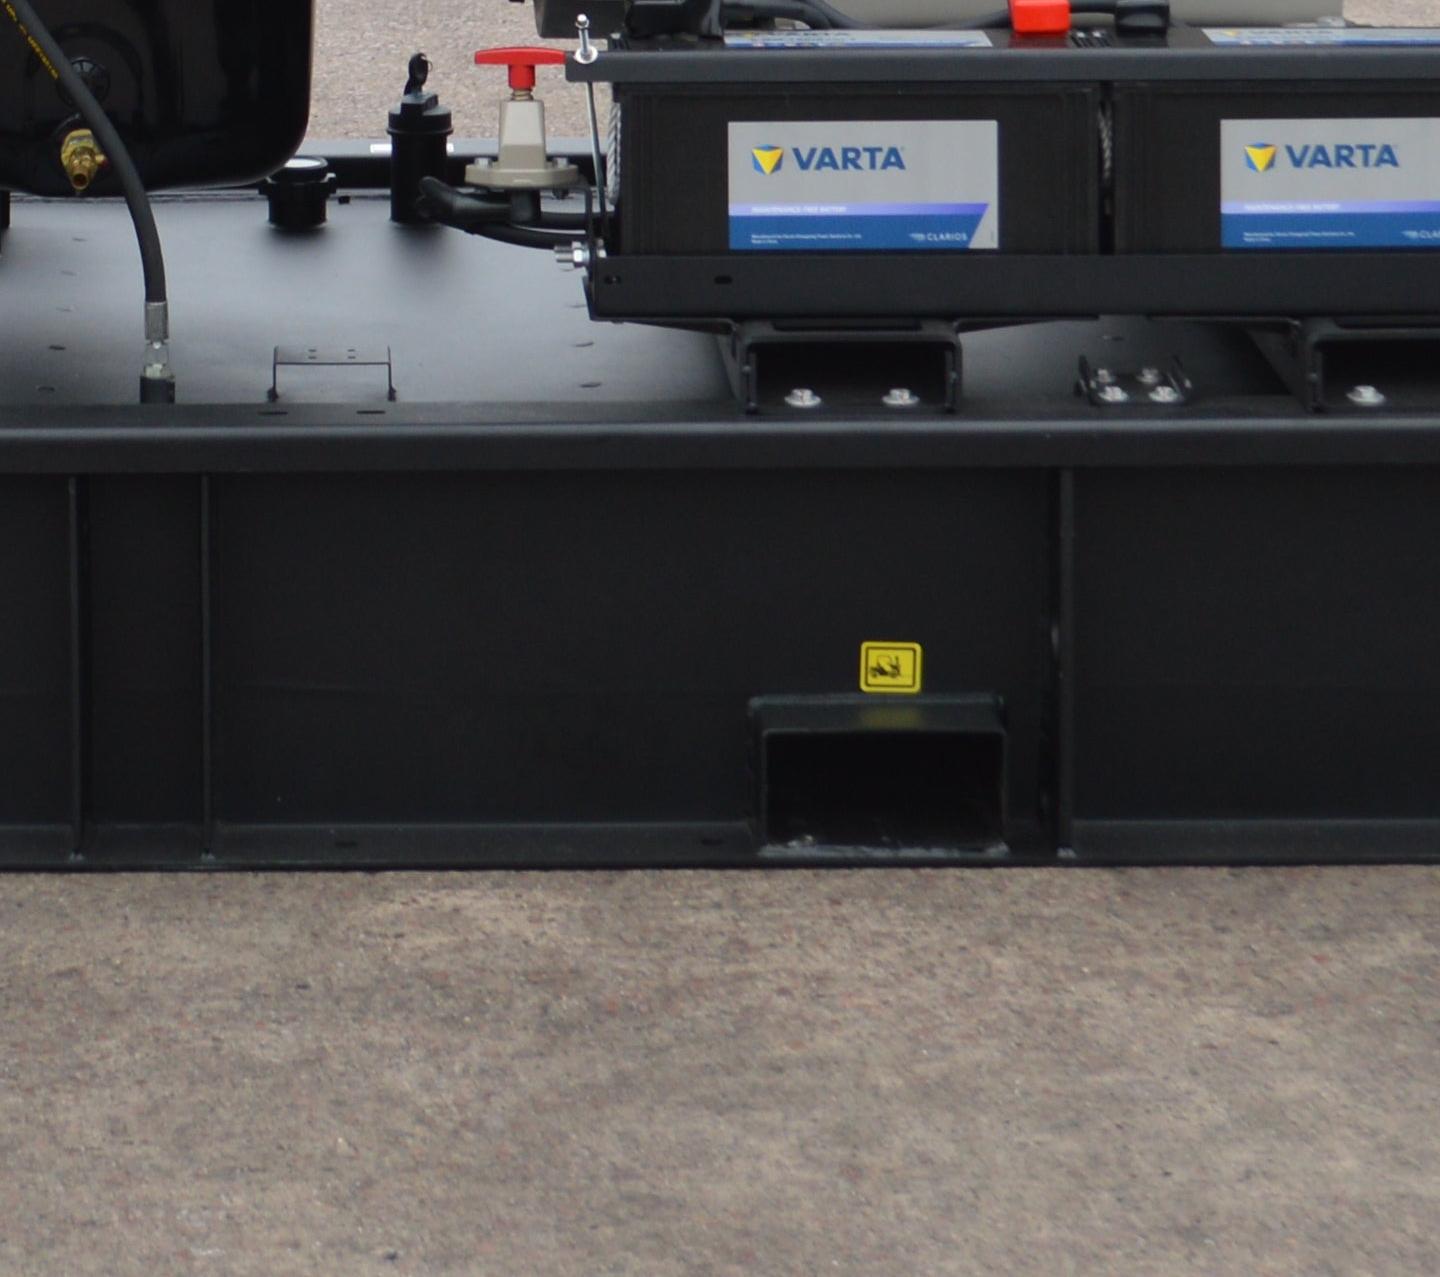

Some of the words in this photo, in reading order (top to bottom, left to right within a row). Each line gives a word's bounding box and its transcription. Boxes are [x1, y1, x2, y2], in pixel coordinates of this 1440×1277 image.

[792, 146, 906, 171] VARTA
[1285, 144, 1400, 168] VARTA
[927, 232, 968, 242] CLARIOS
